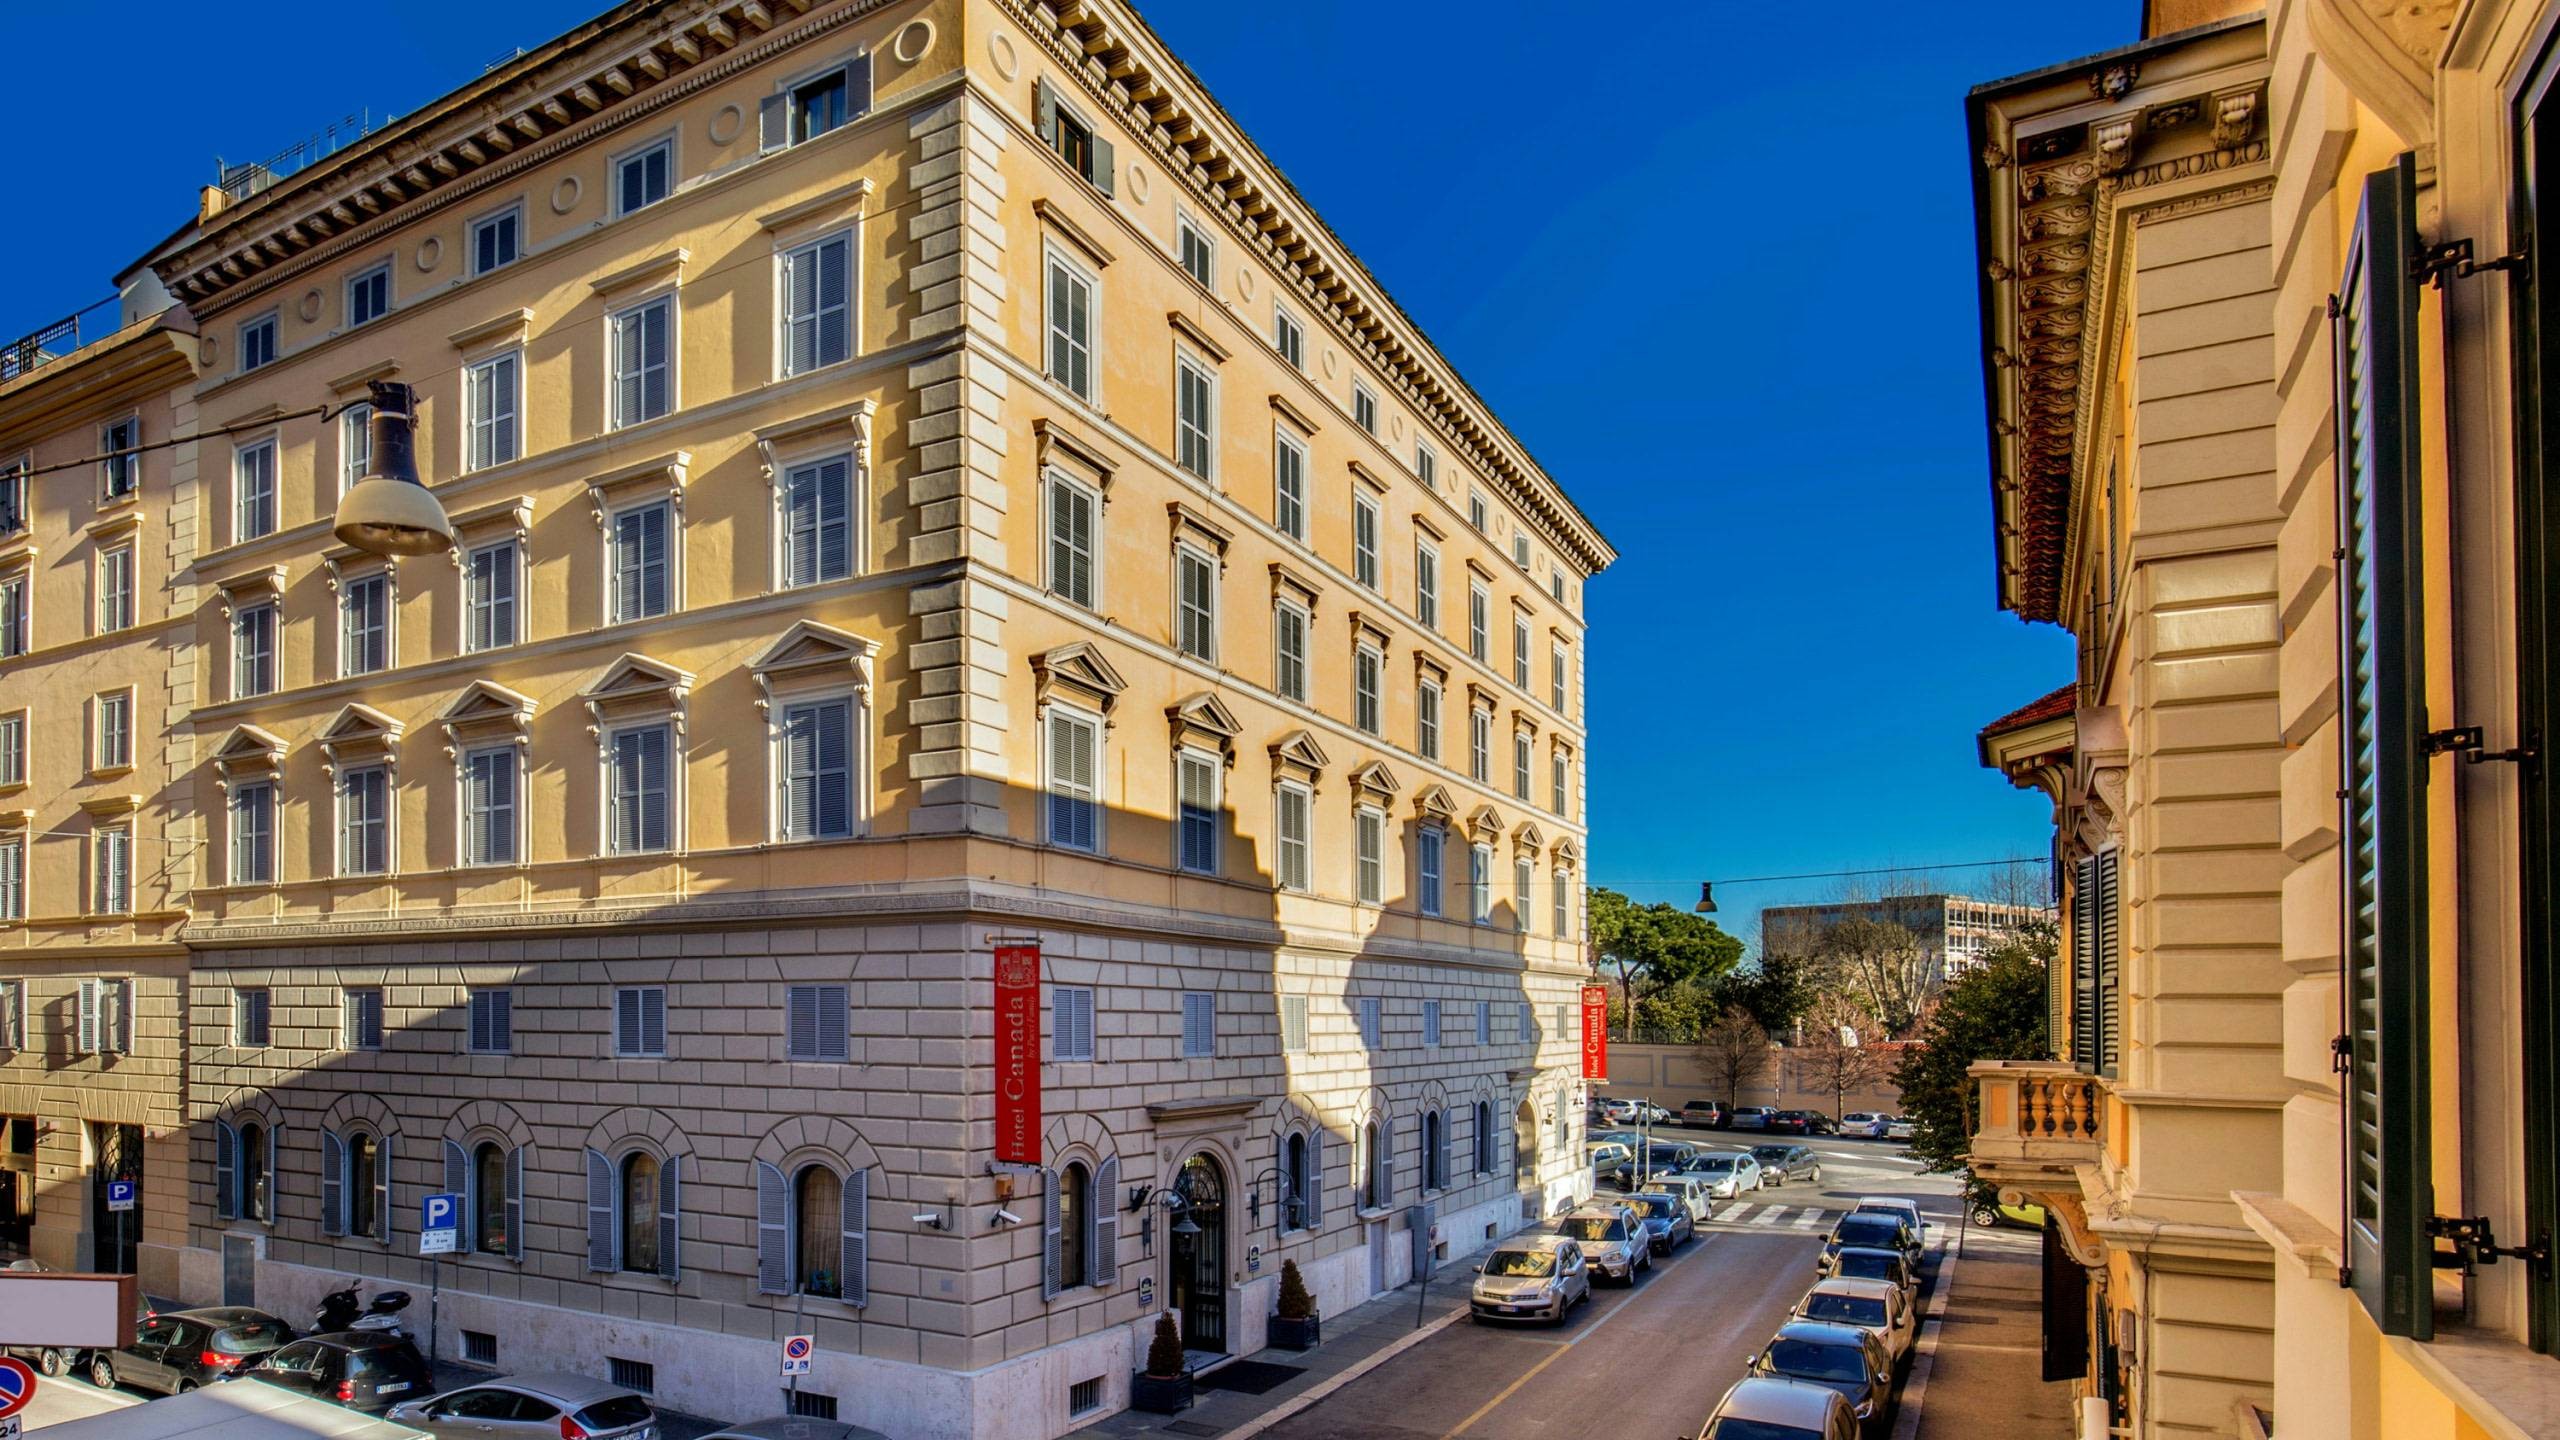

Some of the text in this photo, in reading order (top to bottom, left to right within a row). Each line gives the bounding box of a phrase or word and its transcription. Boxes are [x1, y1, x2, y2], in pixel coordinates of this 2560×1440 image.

[1586, 1008, 1599, 1077] Hotel Canada
[1004, 996, 1025, 1158] Hotel Canada
[114, 1185, 128, 1198] P
[428, 1198, 450, 1227] P
